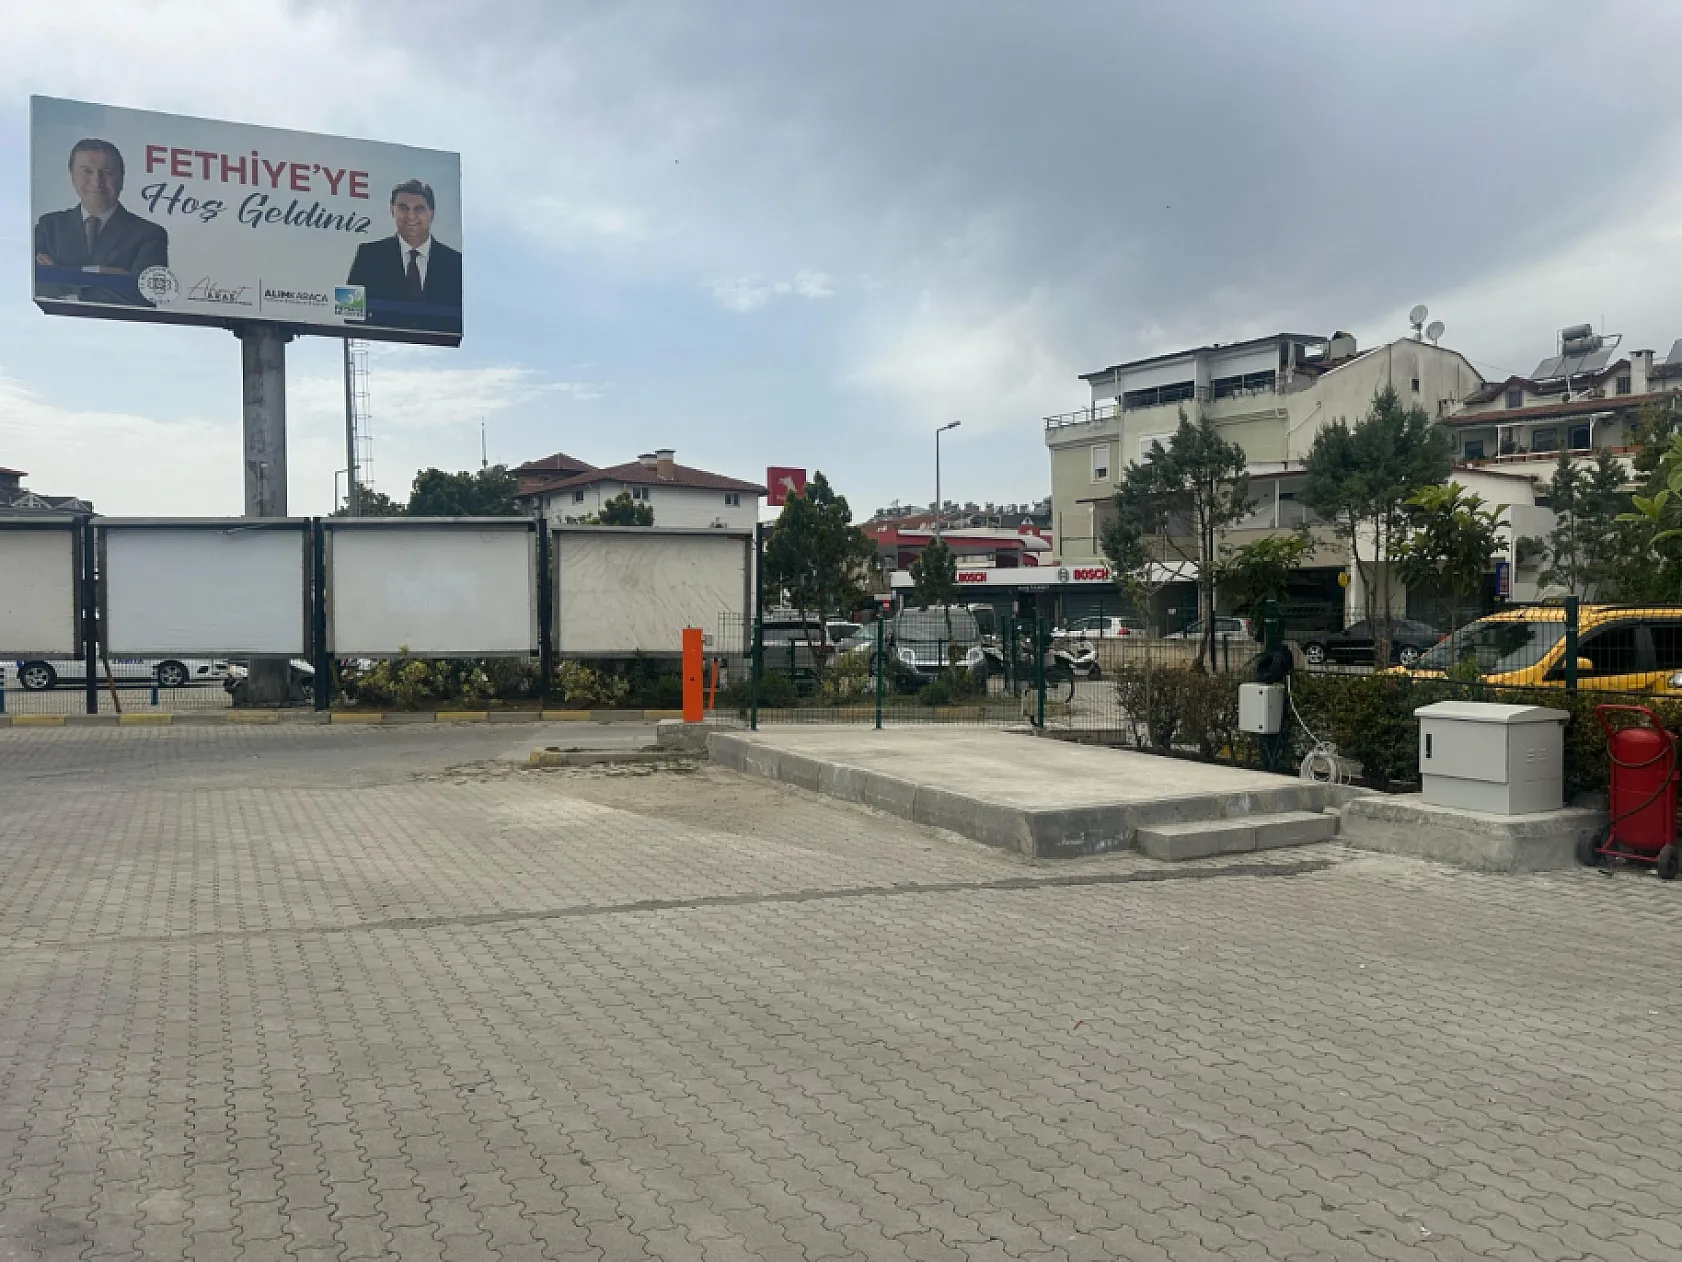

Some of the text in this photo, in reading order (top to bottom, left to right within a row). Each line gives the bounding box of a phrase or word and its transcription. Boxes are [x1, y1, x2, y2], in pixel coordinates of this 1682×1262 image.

[141, 182, 371, 233] Hoş Geldiniz
[1073, 567, 1109, 581] BOSCH
